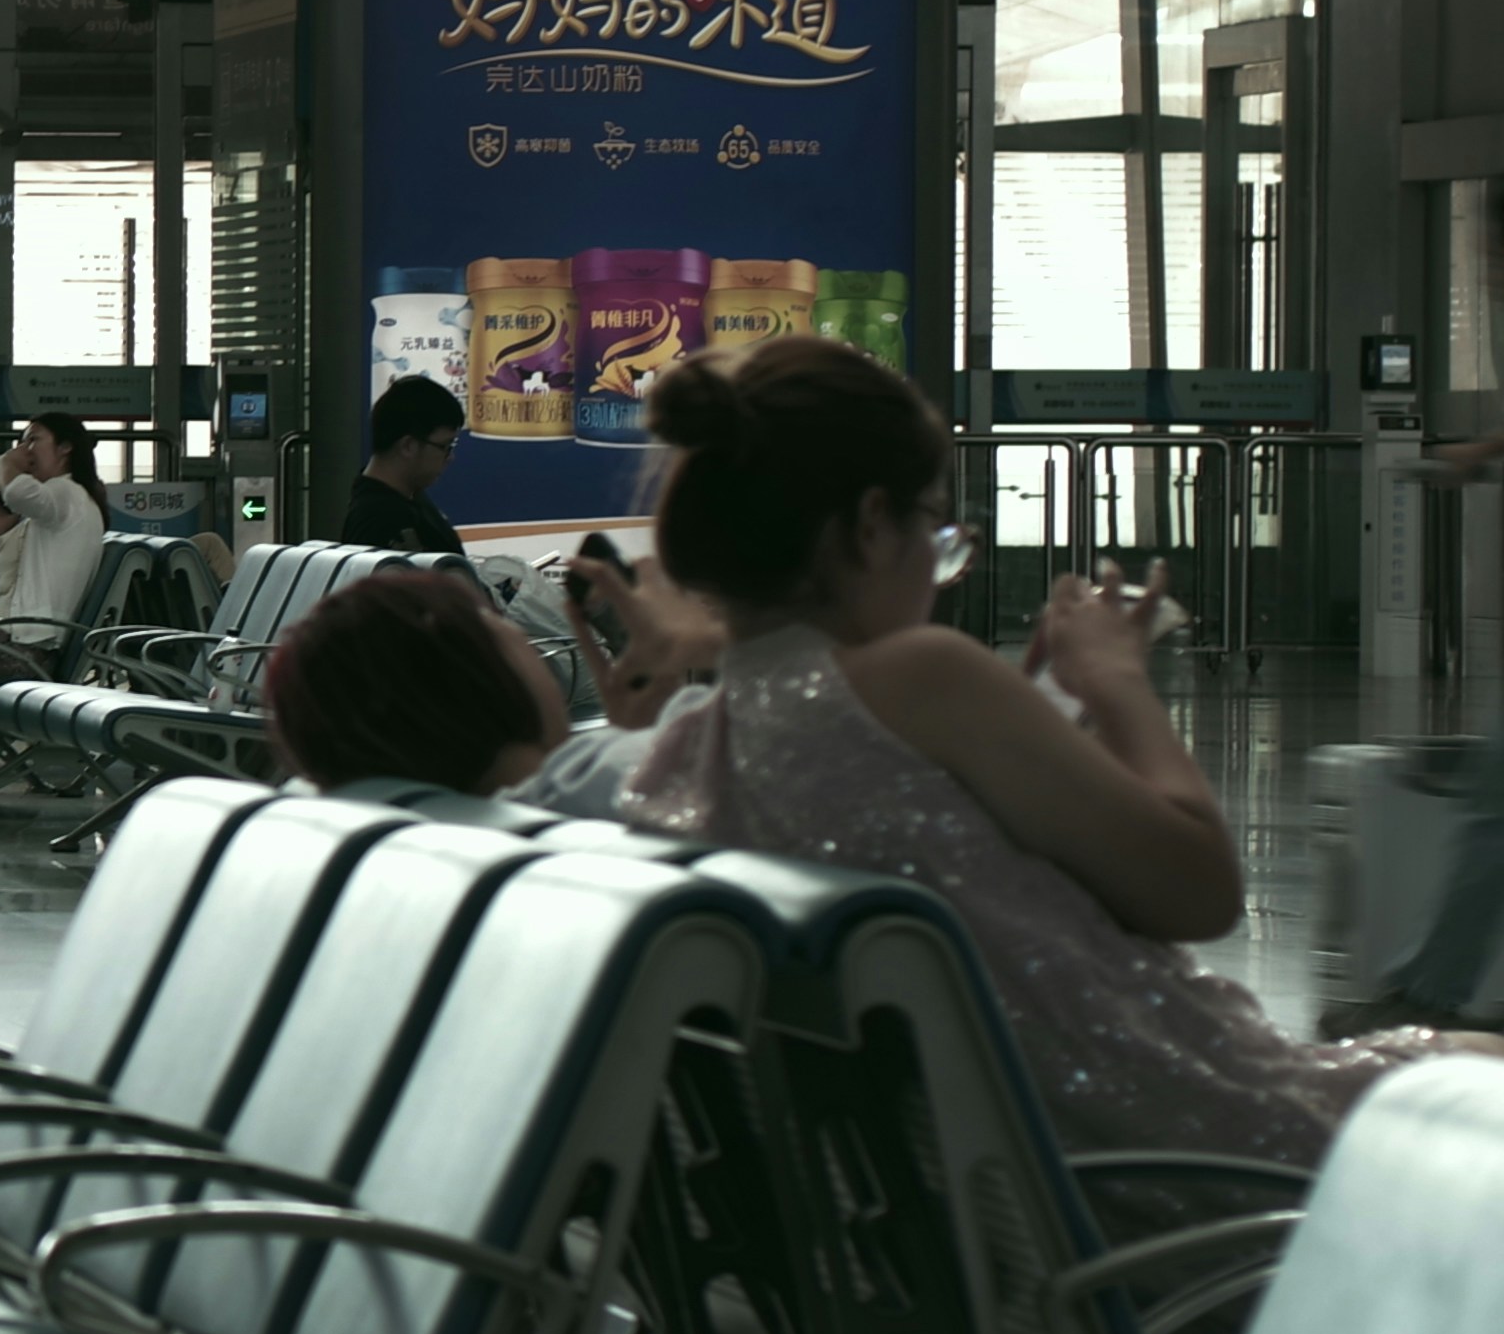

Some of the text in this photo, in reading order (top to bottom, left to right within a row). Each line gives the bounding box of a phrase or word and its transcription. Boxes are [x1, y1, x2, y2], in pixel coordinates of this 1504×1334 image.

[485, 64, 644, 94] 完达山奶粉
[727, 139, 750, 159] 65
[124, 491, 185, 511] 58同城
